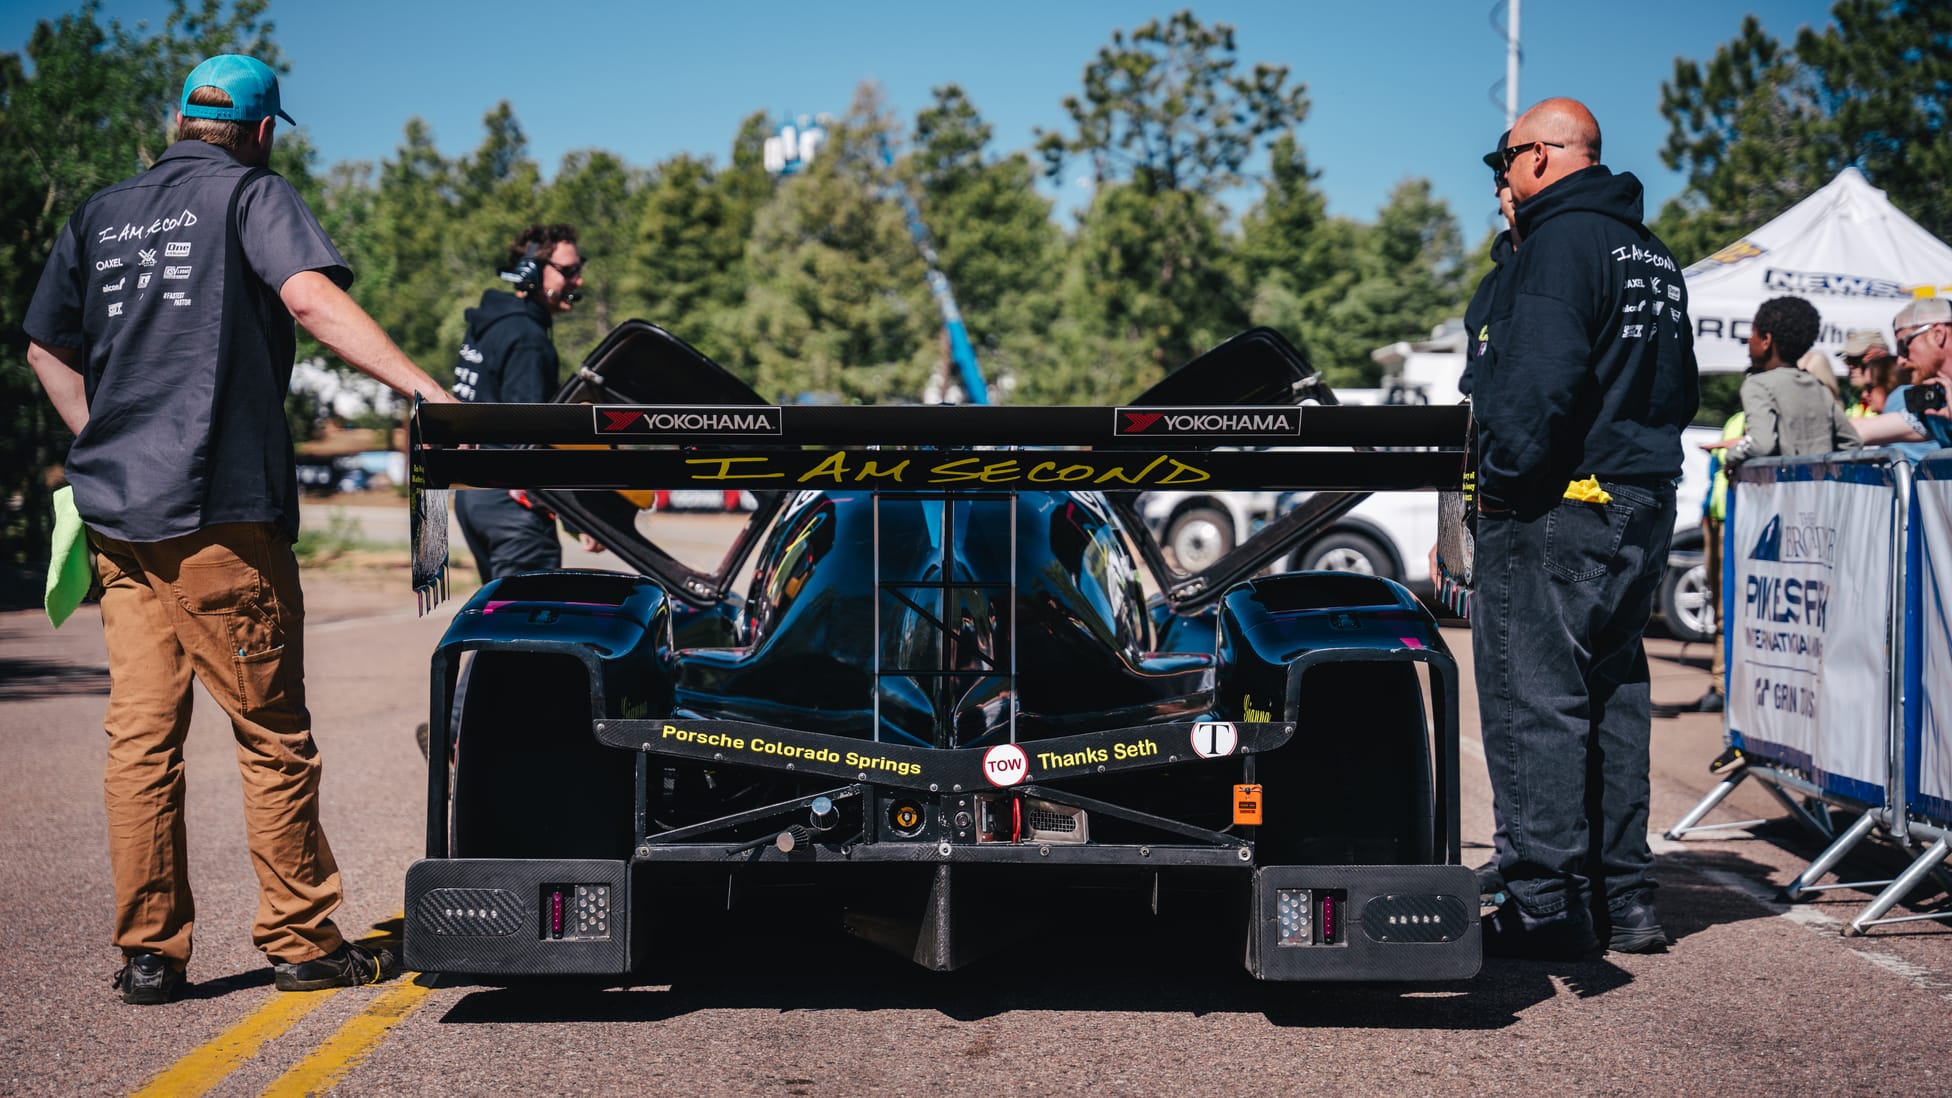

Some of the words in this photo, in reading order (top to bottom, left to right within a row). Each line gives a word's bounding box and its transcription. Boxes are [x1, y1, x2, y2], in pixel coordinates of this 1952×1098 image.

[99, 226, 117, 243] I
[118, 222, 144, 242] AM
[1611, 246, 1631, 262] I
[1625, 278, 1646, 289] AXEL
[642, 414, 771, 430] YOKOHAMA
[1163, 414, 1290, 431] YOKOHAMA
[685, 457, 785, 480] I
[798, 450, 911, 483] AM
[928, 454, 1211, 484] SECOND
[1198, 723, 1230, 755] T
[661, 725, 745, 750] Porsche
[750, 738, 841, 764] Colorado
[845, 751, 922, 776] Springs
[1037, 747, 1109, 770] Thanks
[1113, 739, 1158, 761] Seth
[987, 758, 1022, 773] TOW
